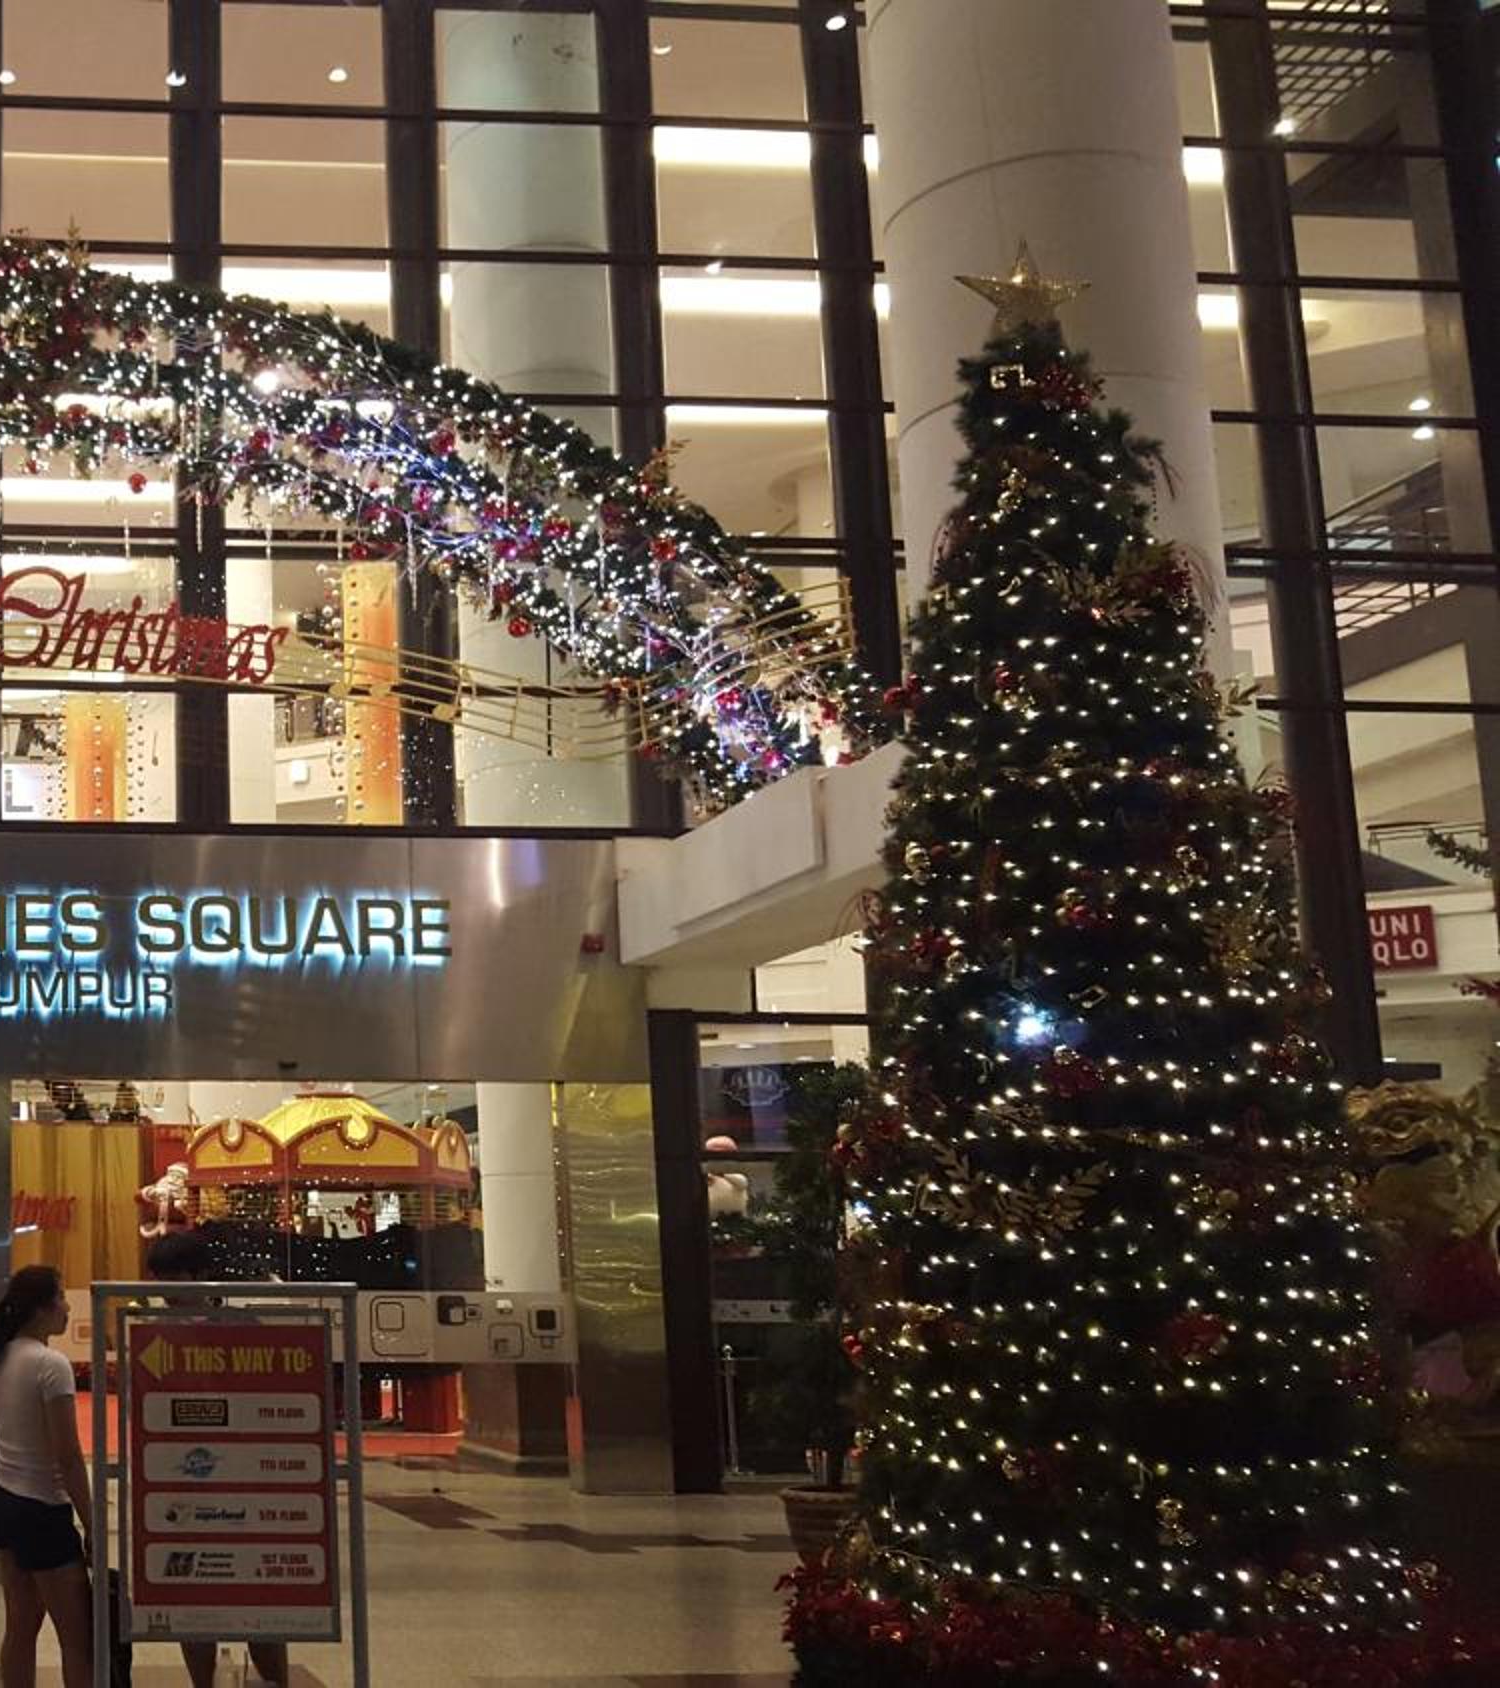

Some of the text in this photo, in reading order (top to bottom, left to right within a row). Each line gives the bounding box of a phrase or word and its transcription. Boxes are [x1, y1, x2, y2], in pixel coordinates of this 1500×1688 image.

[138, 896, 452, 957] SQUARE
[1369, 914, 1421, 937] UNI
[1372, 939, 1428, 965] QLO
[183, 1347, 312, 1373] THIS WAY TO:
